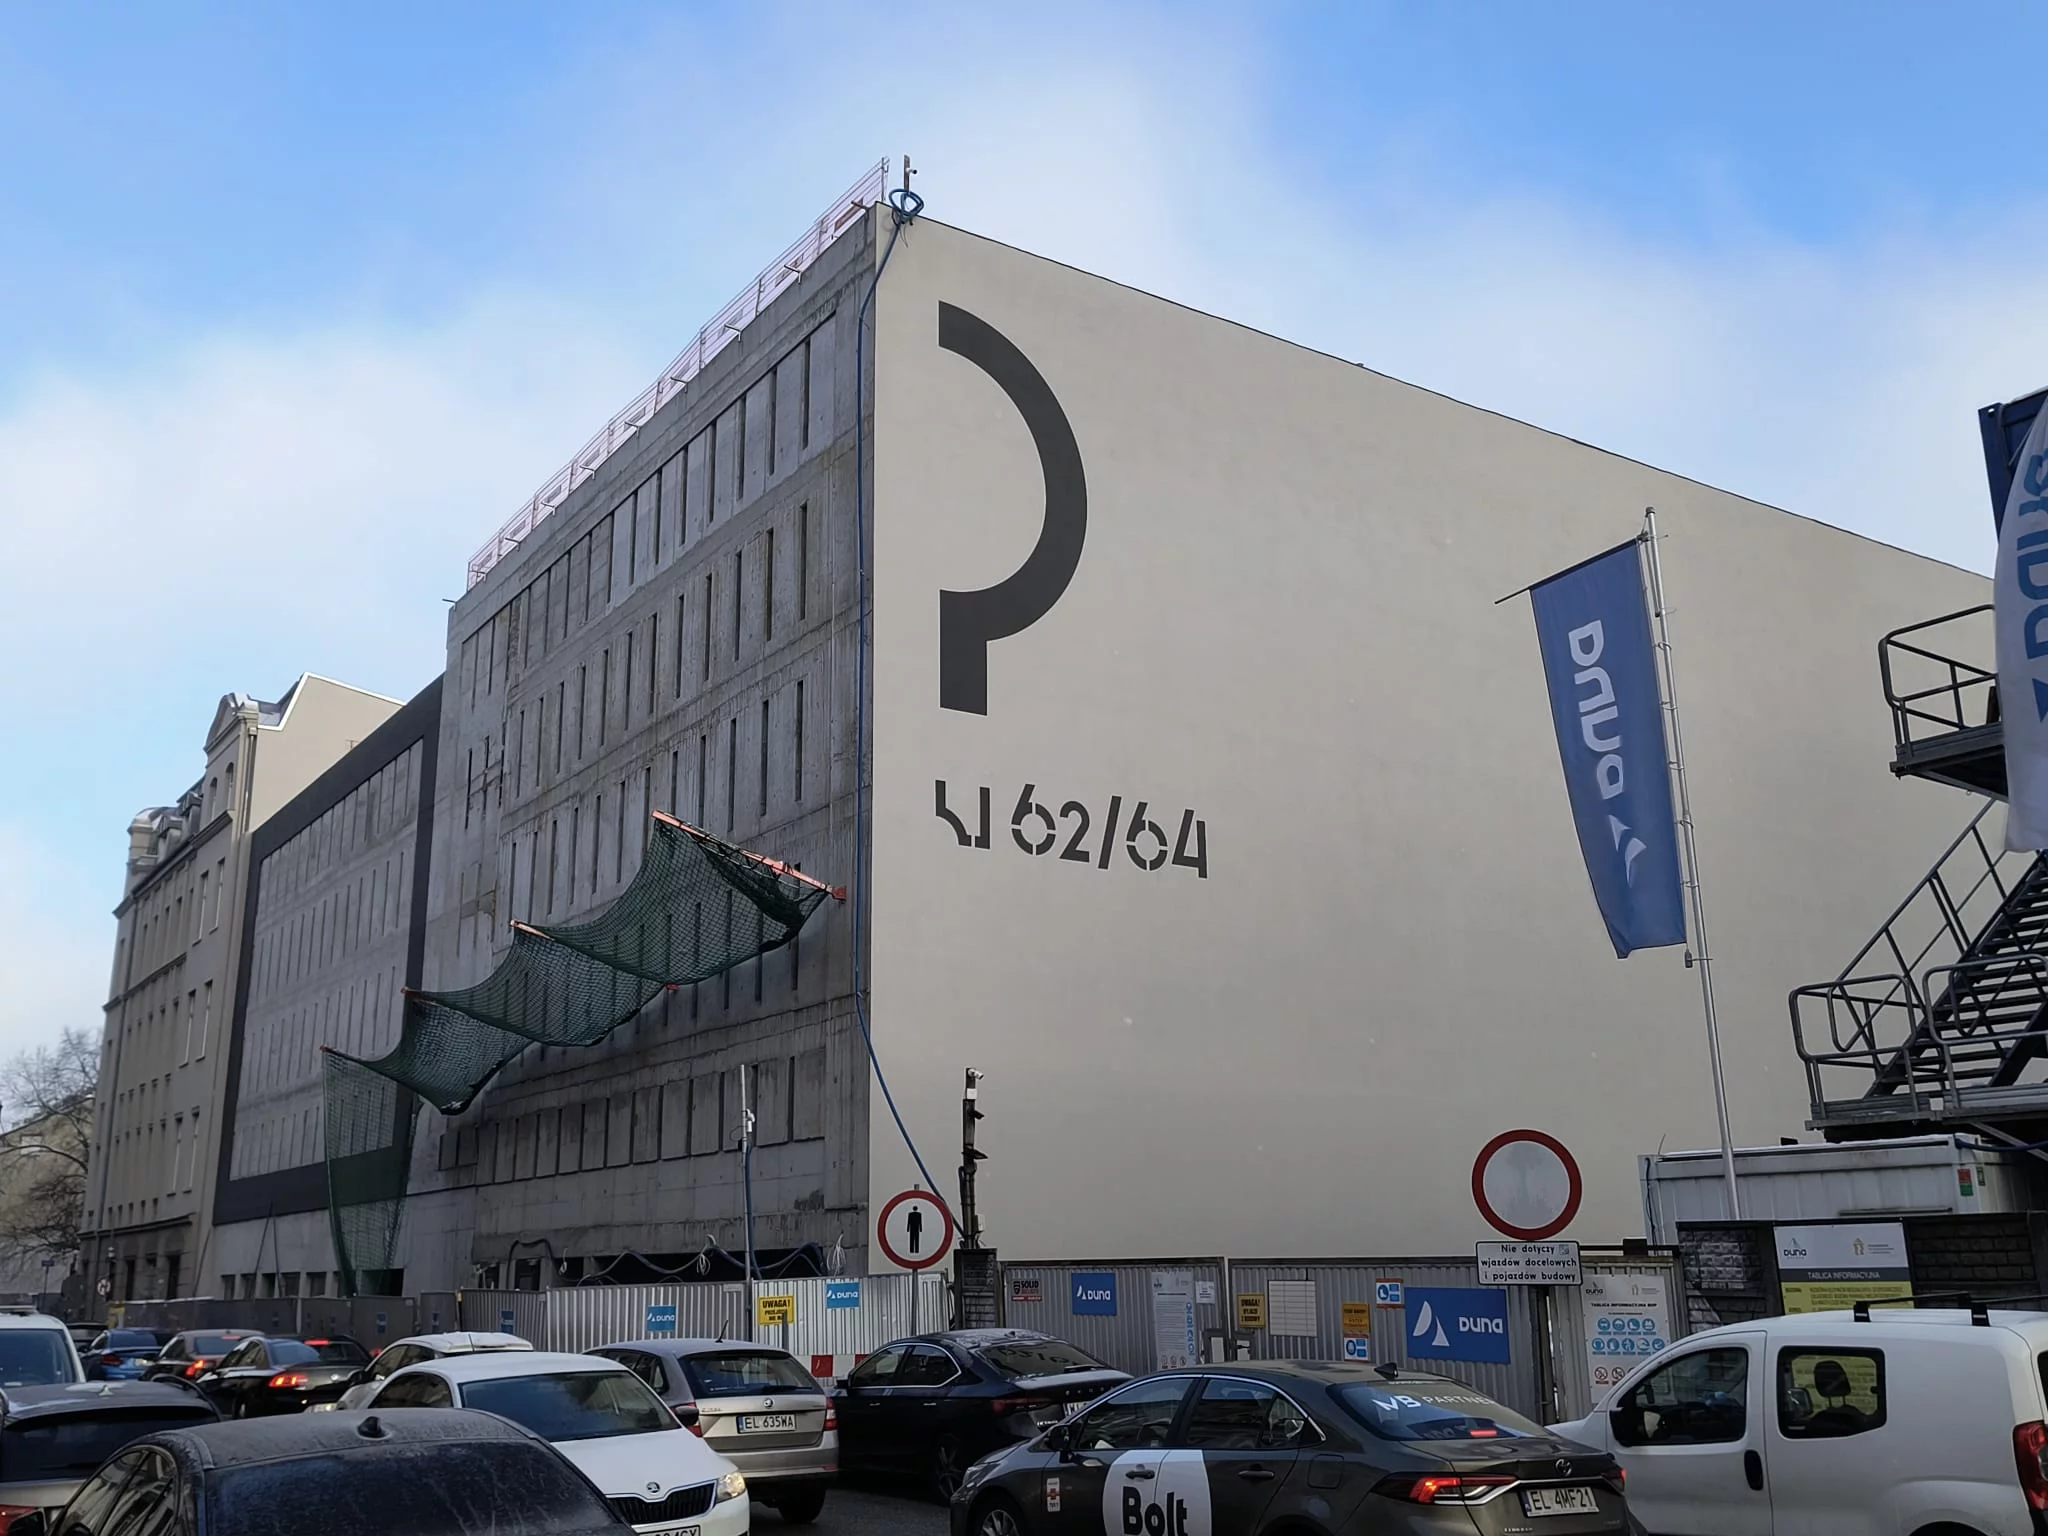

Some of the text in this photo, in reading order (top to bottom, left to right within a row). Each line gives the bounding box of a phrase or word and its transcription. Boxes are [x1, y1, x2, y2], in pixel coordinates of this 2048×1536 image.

[1010, 783, 1208, 879] 62/64
[1501, 1244, 1555, 1256] Nie dotyczy
[1481, 1257, 1577, 1268] wjazdów docelowych
[1493, 1271, 1537, 1282] pojazdów
[1541, 1271, 1576, 1282] budowy
[1021, 1280, 1039, 1288] SOLID
[744, 1414, 794, 1430] EL 635WA
[1529, 1486, 1597, 1511] EL 4MF21
[1123, 1486, 1188, 1536] Bolt
